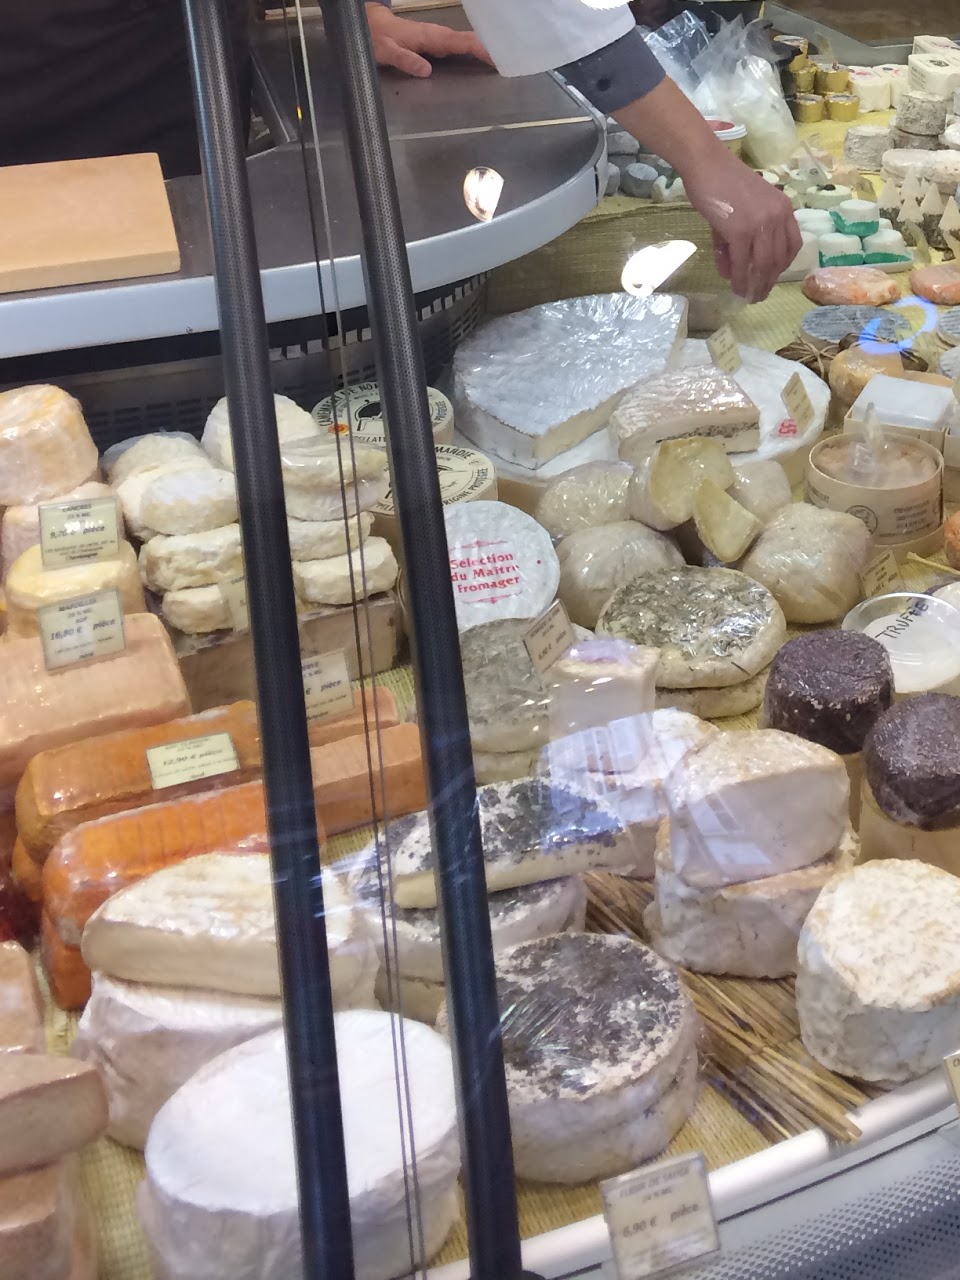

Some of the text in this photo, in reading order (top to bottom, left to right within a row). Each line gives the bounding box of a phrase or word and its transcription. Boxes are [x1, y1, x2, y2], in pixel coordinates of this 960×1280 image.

[434, 445, 476, 461] MANDIE
[442, 487, 473, 507] RIGINE
[450, 571, 468, 583] du
[92, 618, 116, 631] pièce
[320, 679, 342, 692] pièce
[670, 1203, 699, 1222] pièce
